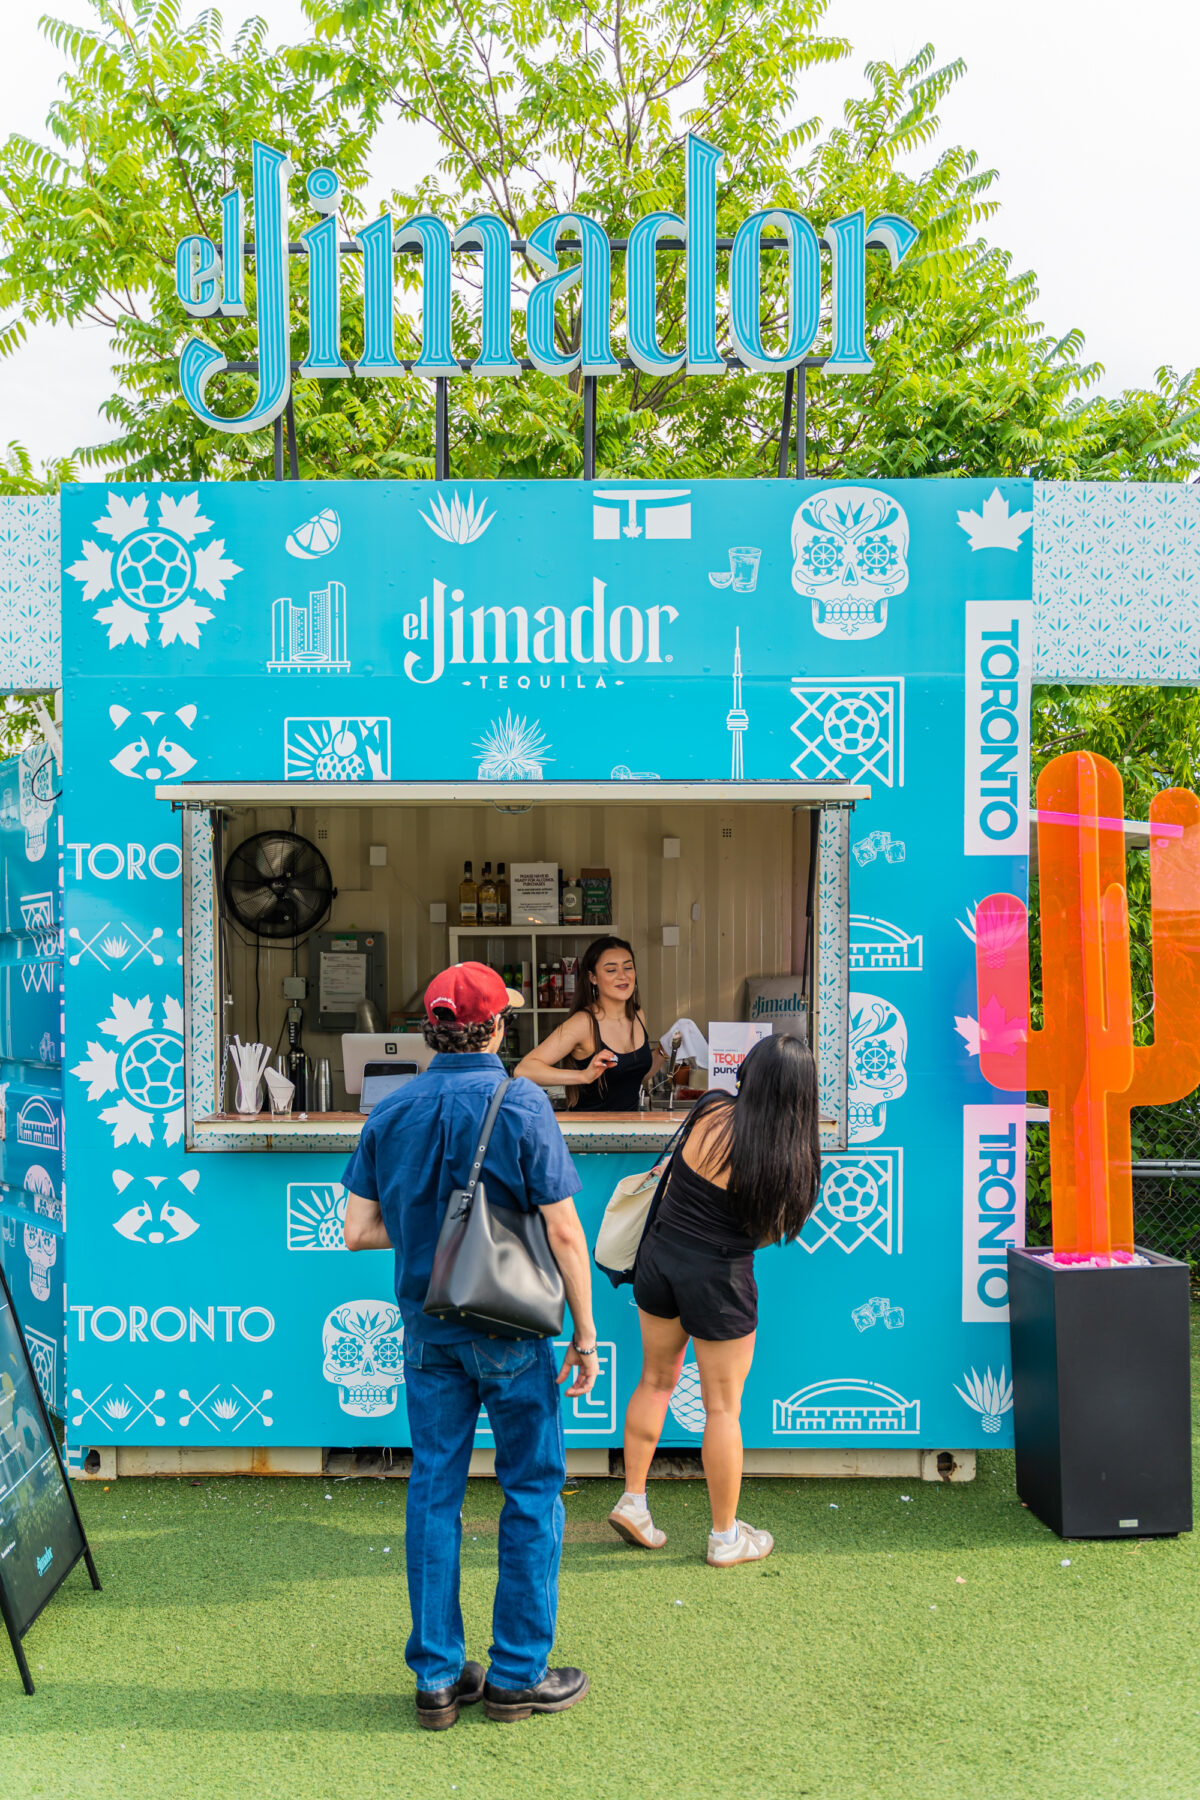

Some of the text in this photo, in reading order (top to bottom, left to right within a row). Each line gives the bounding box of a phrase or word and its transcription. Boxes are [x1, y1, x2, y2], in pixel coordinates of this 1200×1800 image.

[176, 132, 920, 434] el Jimador
[402, 576, 680, 684] el Jimador
[479, 675, 607, 690] TEQUILA
[979, 618, 1019, 841] TORONTO
[752, 992, 806, 1018] Jimado
[713, 1065, 738, 1076] punc
[70, 1305, 275, 1343] TORONTO
